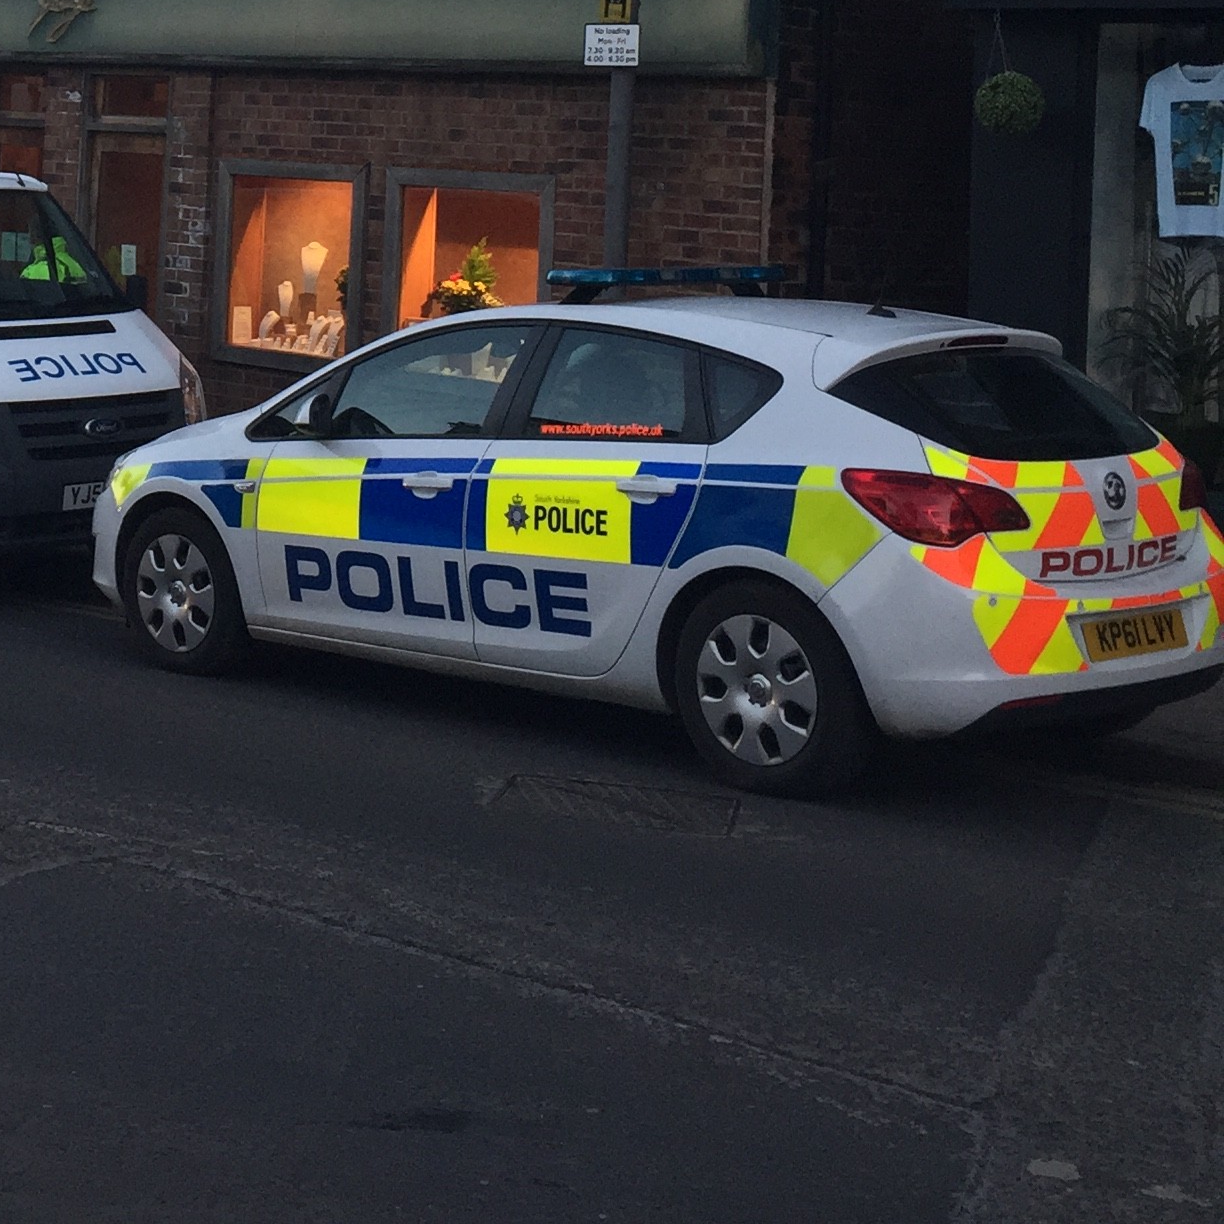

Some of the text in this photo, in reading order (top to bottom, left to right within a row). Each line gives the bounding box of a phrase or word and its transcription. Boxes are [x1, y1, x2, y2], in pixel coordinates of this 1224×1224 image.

[540, 421, 664, 437] www.southyorks.police.uk
[533, 504, 608, 537] POLICE
[1039, 534, 1178, 578] POLICE
[284, 543, 592, 638] POLICE
